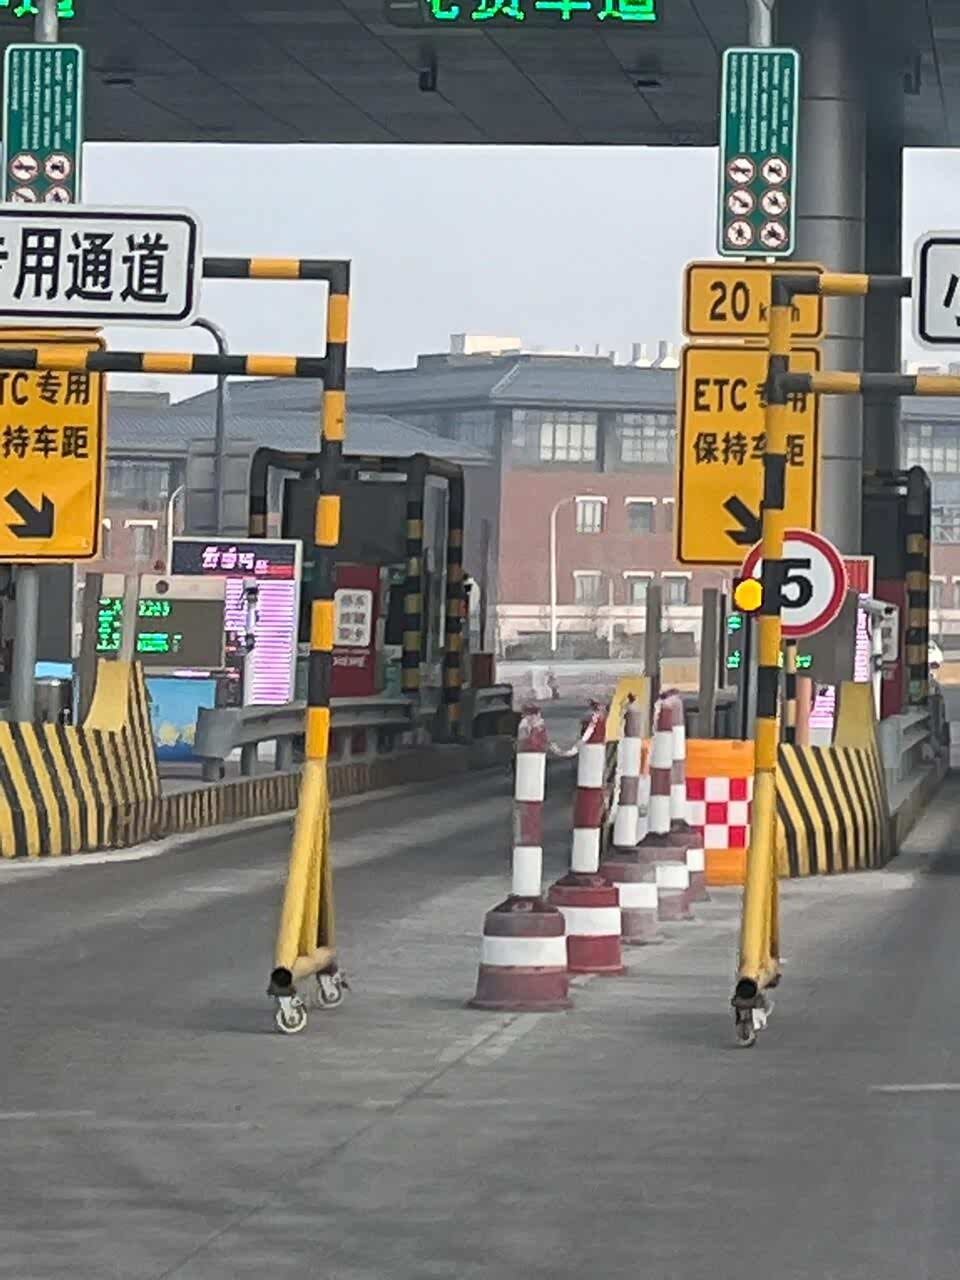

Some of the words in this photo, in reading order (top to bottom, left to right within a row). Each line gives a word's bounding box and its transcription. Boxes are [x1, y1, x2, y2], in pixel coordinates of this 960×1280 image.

[0, 227, 169, 303] 用通道
[709, 281, 750, 322] 20
[36, 371, 90, 405] 专用
[693, 378, 748, 413] ETC
[2, 424, 89, 459] 持车距
[778, 558, 814, 609] 5
